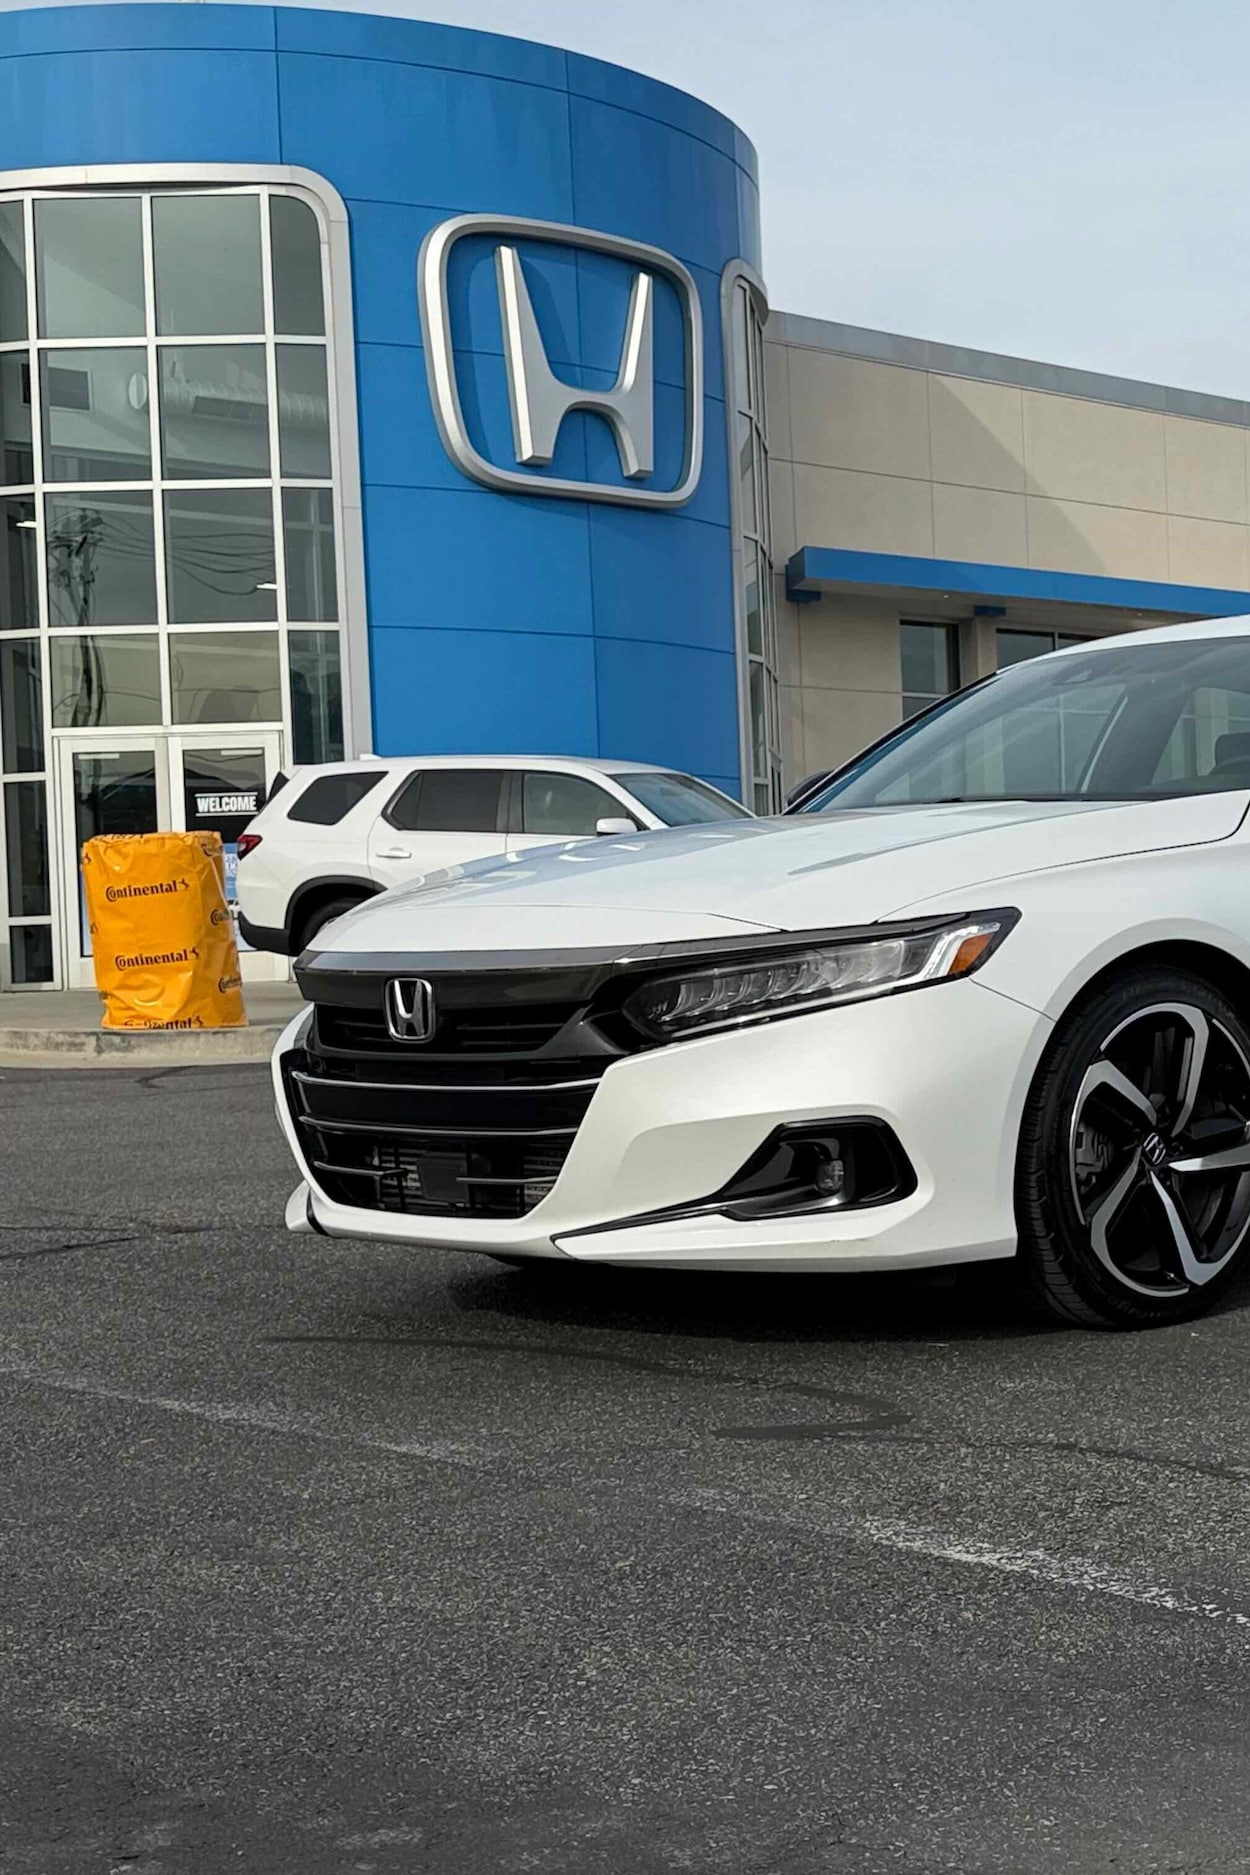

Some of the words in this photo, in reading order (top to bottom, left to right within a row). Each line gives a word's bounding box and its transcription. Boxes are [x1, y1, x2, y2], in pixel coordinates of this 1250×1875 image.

[196, 796, 257, 812] WELCOME
[106, 880, 177, 902] Continental
[115, 949, 188, 971] Continental
